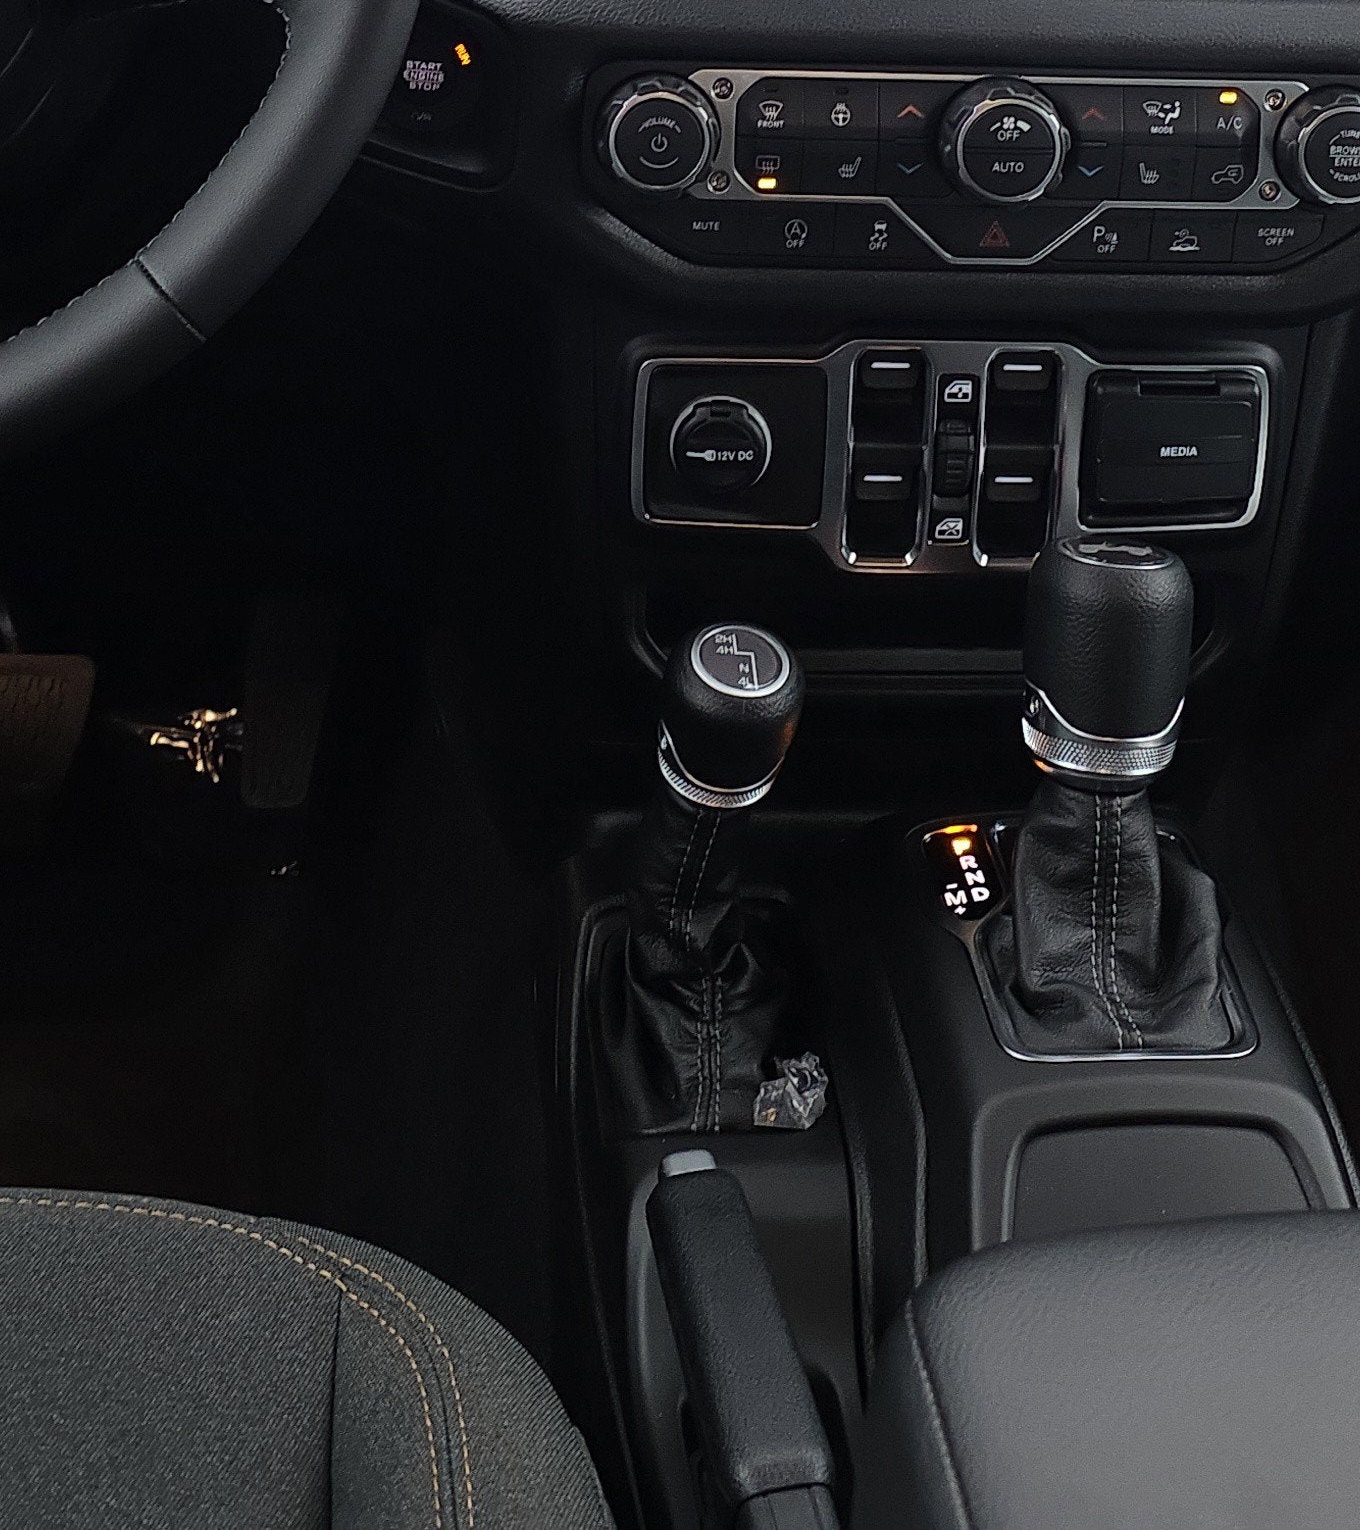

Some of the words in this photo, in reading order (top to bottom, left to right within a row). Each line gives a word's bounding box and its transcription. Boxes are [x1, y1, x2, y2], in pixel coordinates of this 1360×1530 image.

[454, 43, 472, 66] RUN
[405, 60, 443, 70] START
[409, 80, 440, 92] STOP
[757, 118, 785, 130] FRONT
[1217, 116, 1243, 131] A/C
[996, 129, 1021, 142] OFF
[1149, 125, 1175, 135] MODE
[991, 160, 1025, 174] AUTO
[692, 220, 720, 232] MUTE
[1257, 227, 1295, 239] SCREEN
[786, 238, 805, 249] OFF
[868, 240, 888, 251] OFF
[1265, 235, 1284, 246] OFF
[1097, 242, 1116, 254] OFF
[716, 450, 736, 461] 12V
[737, 450, 755, 462] DC
[1159, 445, 1198, 458] MEDIA
[714, 633, 732, 644] 2H
[715, 645, 734, 655] 4H
[738, 662, 750, 674] N
[737, 676, 754, 689] 4L
[959, 855, 978, 870] R
[964, 869, 986, 886] N
[943, 889, 968, 907] M
[970, 886, 990, 902] D
